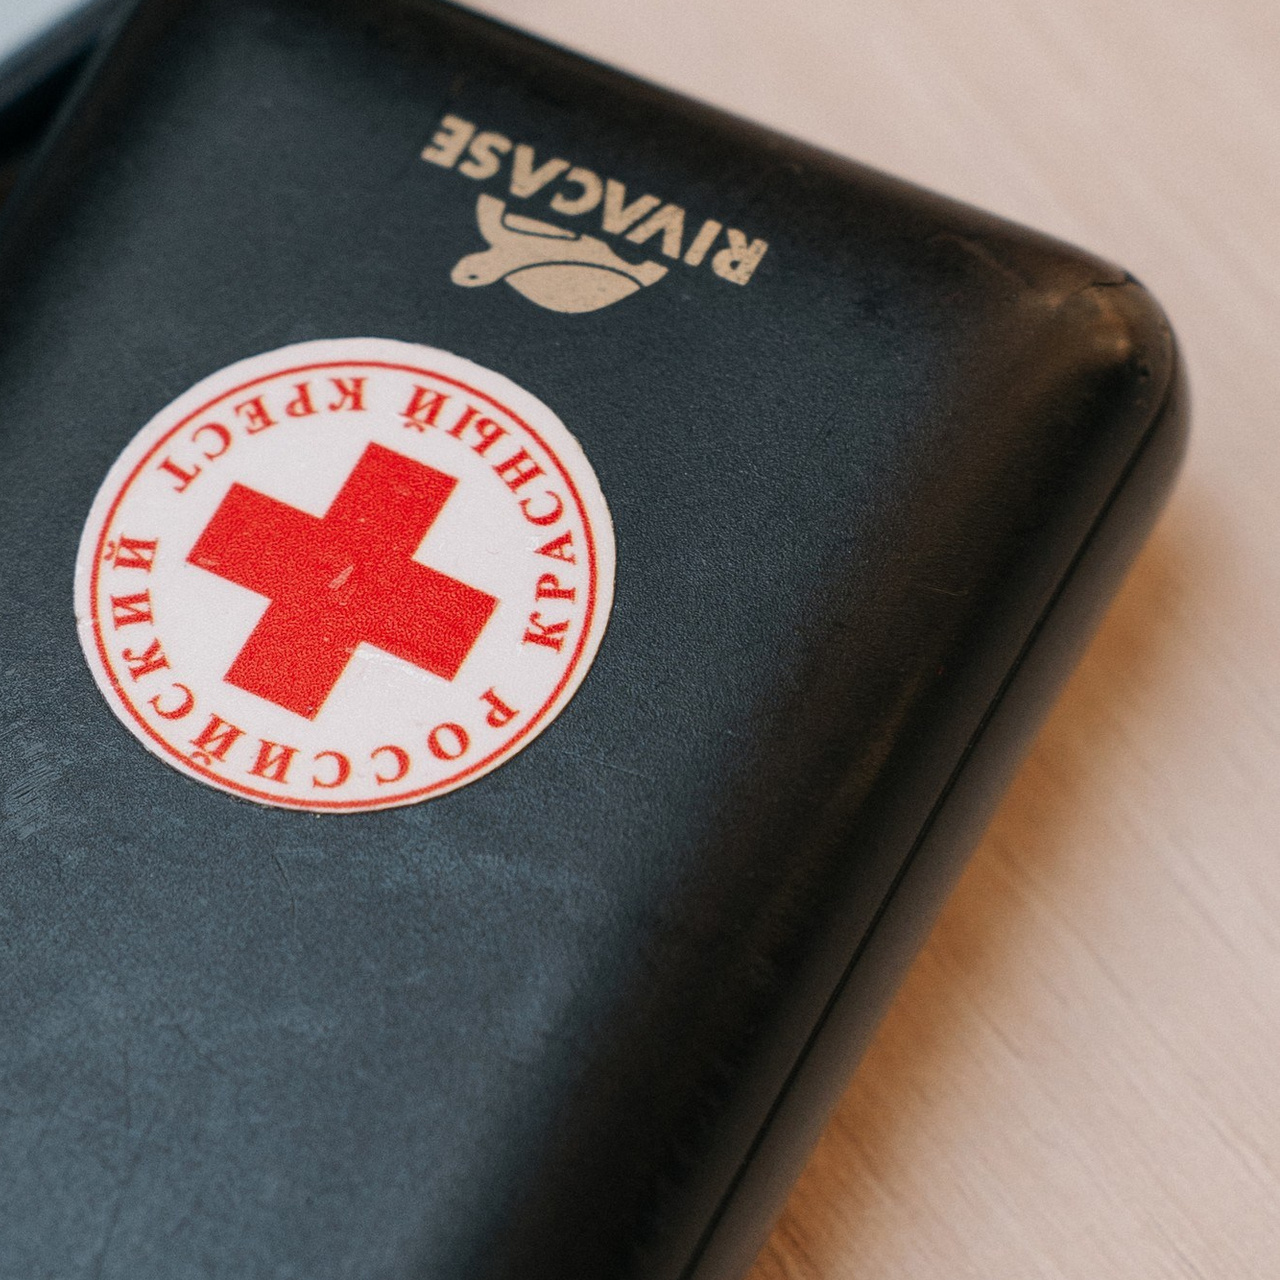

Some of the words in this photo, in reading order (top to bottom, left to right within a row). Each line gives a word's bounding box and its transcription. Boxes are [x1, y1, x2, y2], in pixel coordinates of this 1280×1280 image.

[421, 115, 769, 286] RIVACASE
[155, 375, 370, 494] КРЕСТ
[399, 384, 577, 653] КРАСНЫЙ
[104, 535, 520, 790] РОССИЙСКИЙ
